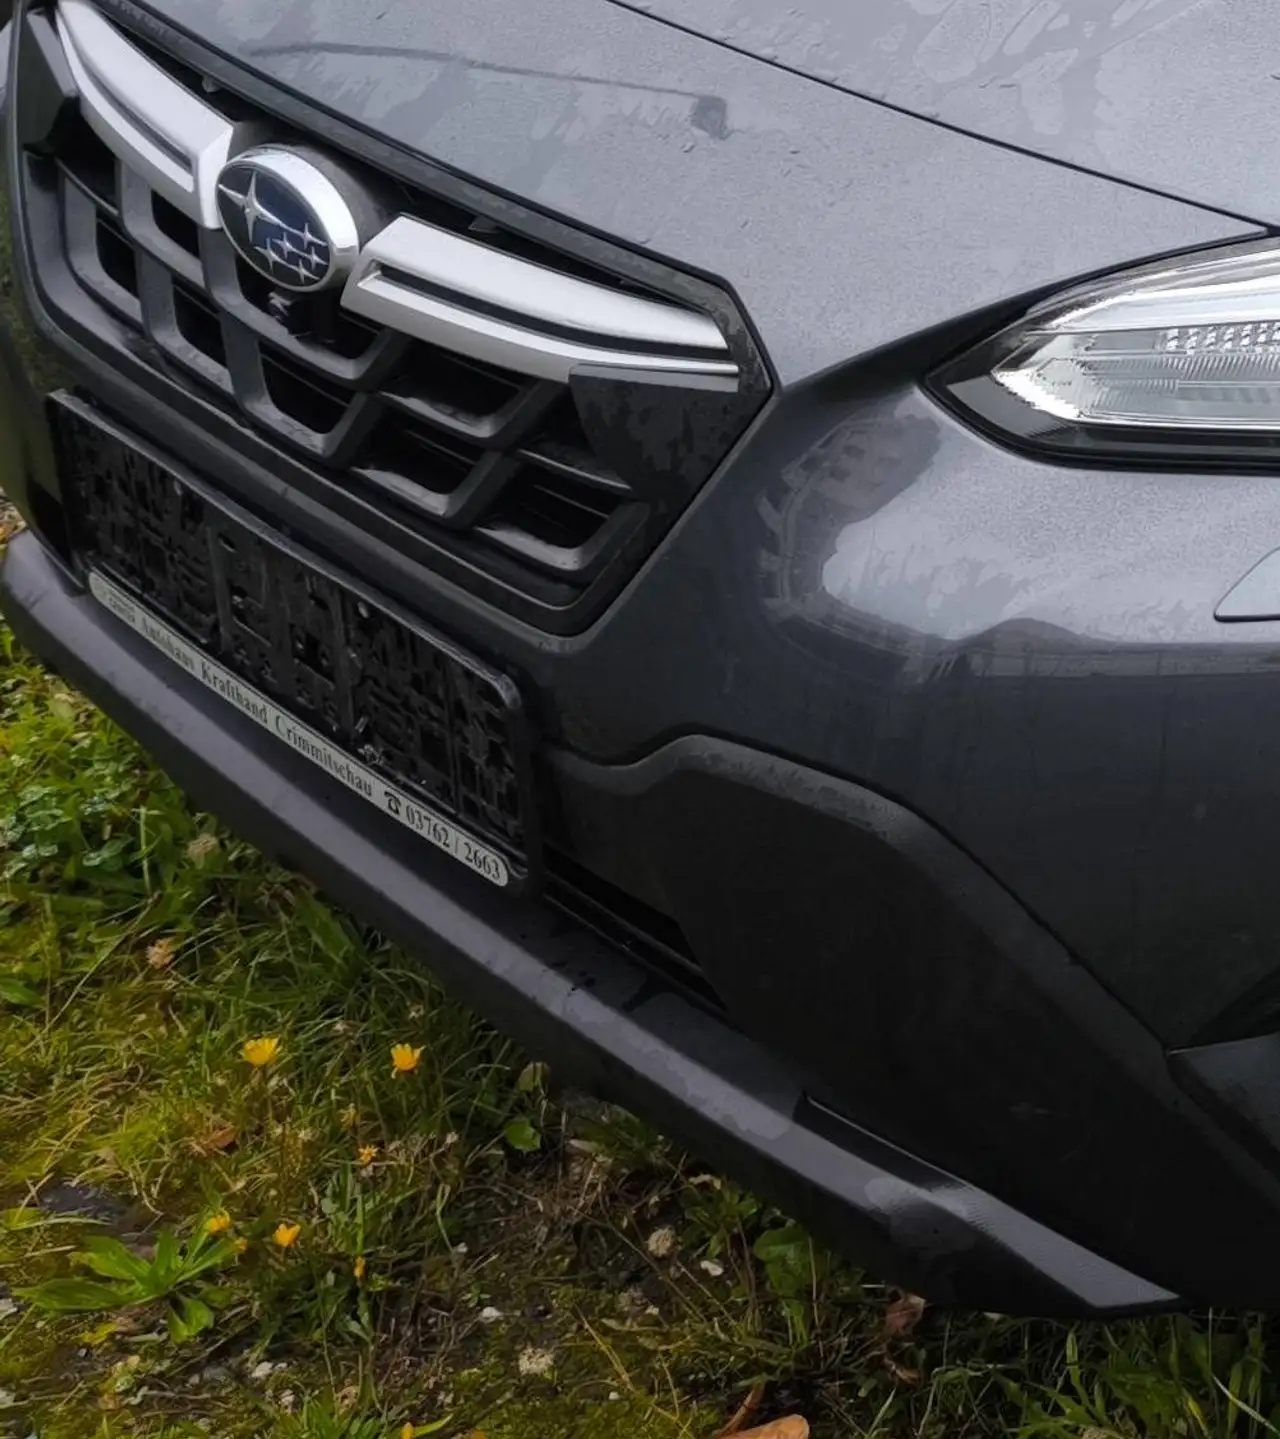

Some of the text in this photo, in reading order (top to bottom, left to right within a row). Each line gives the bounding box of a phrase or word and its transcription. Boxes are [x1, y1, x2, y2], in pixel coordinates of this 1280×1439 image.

[275, 715, 372, 797] Crimmitschau
[405, 804, 450, 847] 03762
[464, 842, 500, 880] 2663
